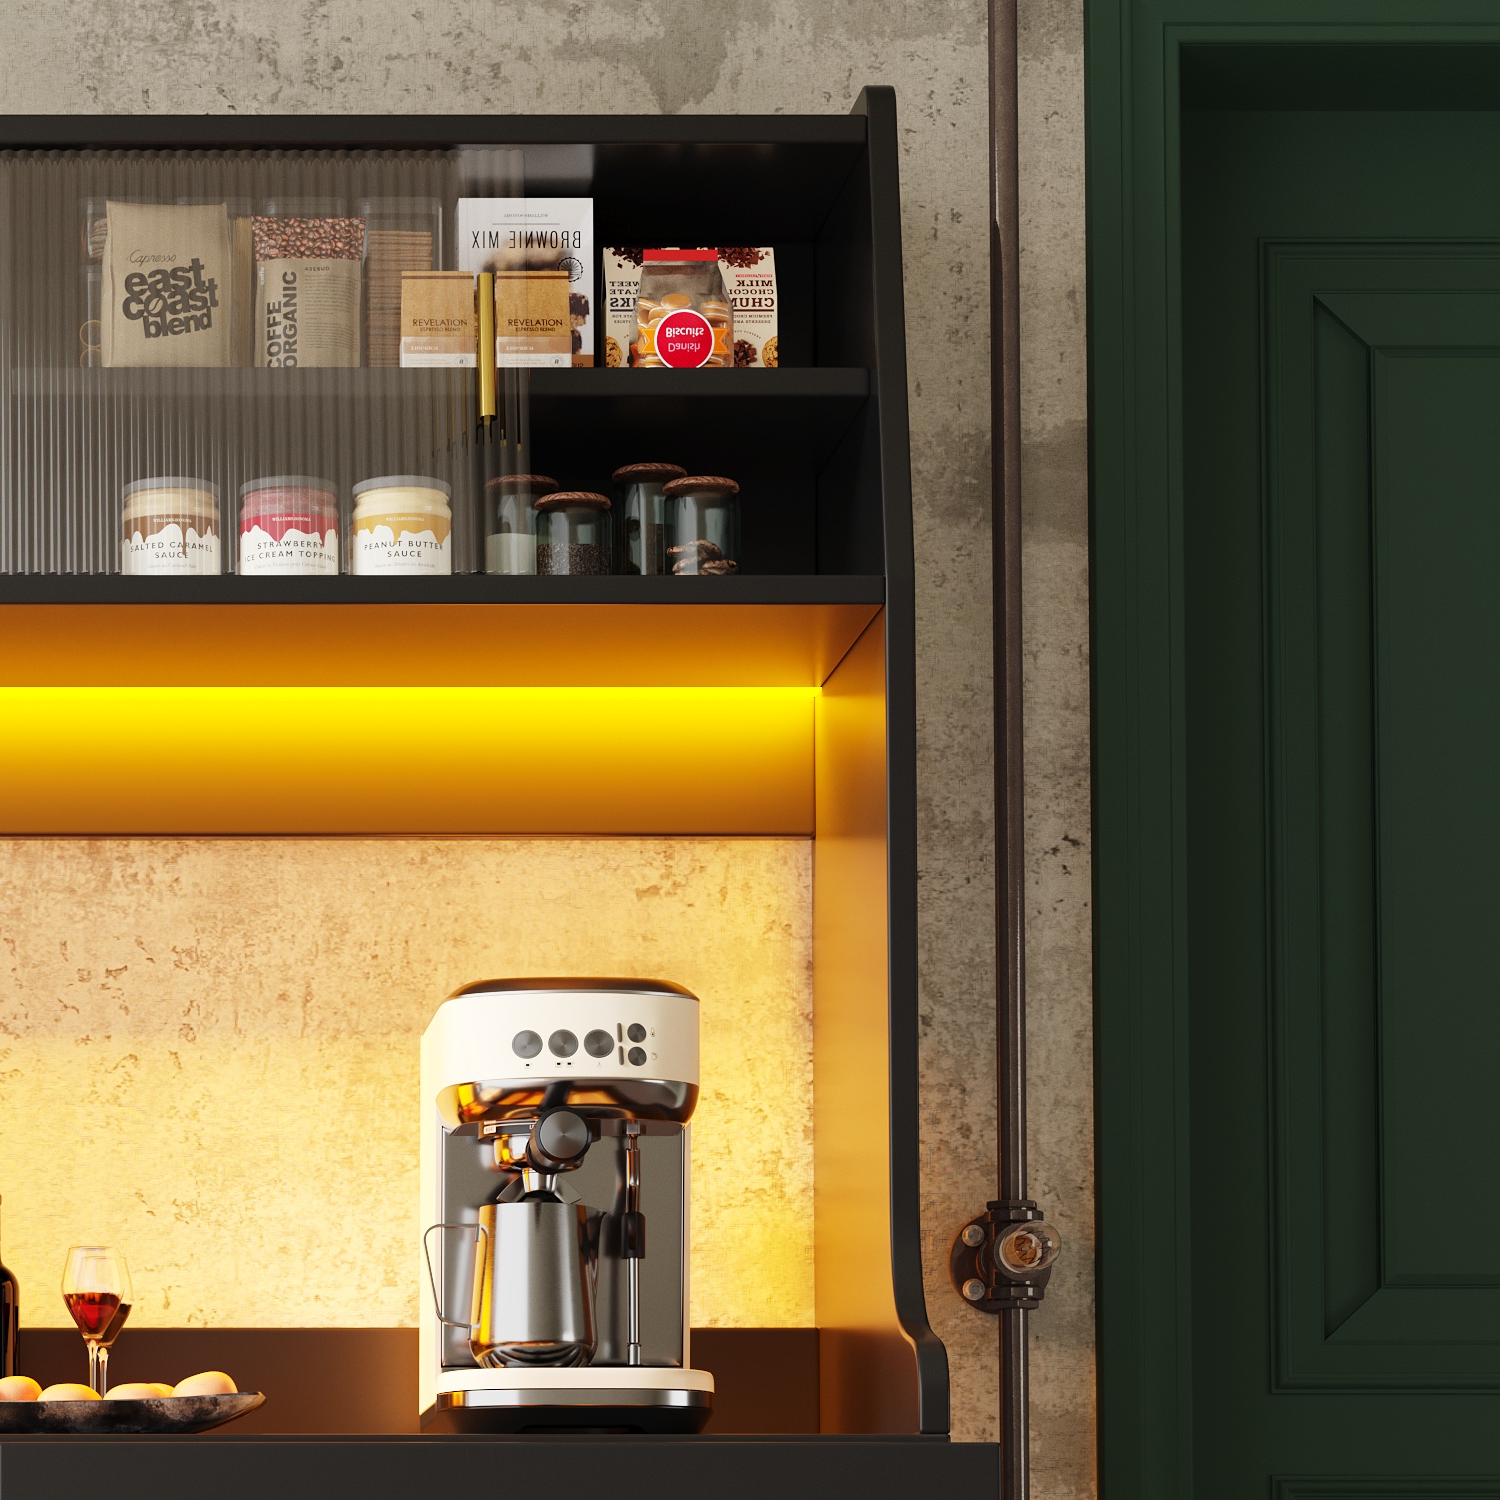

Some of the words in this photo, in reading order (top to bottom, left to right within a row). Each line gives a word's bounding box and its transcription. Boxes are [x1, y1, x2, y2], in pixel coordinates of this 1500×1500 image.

[126, 249, 177, 267] Capresso
[125, 258, 204, 298] east
[122, 278, 219, 320] coast
[143, 306, 212, 338] blend
[282, 271, 298, 368] ORGANIC
[412, 319, 467, 327] REVELATION
[507, 319, 563, 327] REVELATION
[130, 541, 164, 553] SALTED
[169, 541, 213, 553] CARAMEL
[257, 540, 323, 549] STRAWBERRY
[364, 540, 402, 551] PEANUT
[408, 540, 443, 551] BUTTER
[244, 554, 255, 563] ICE
[258, 550, 293, 559] CREAM
[298, 550, 336, 562] TOPPING
